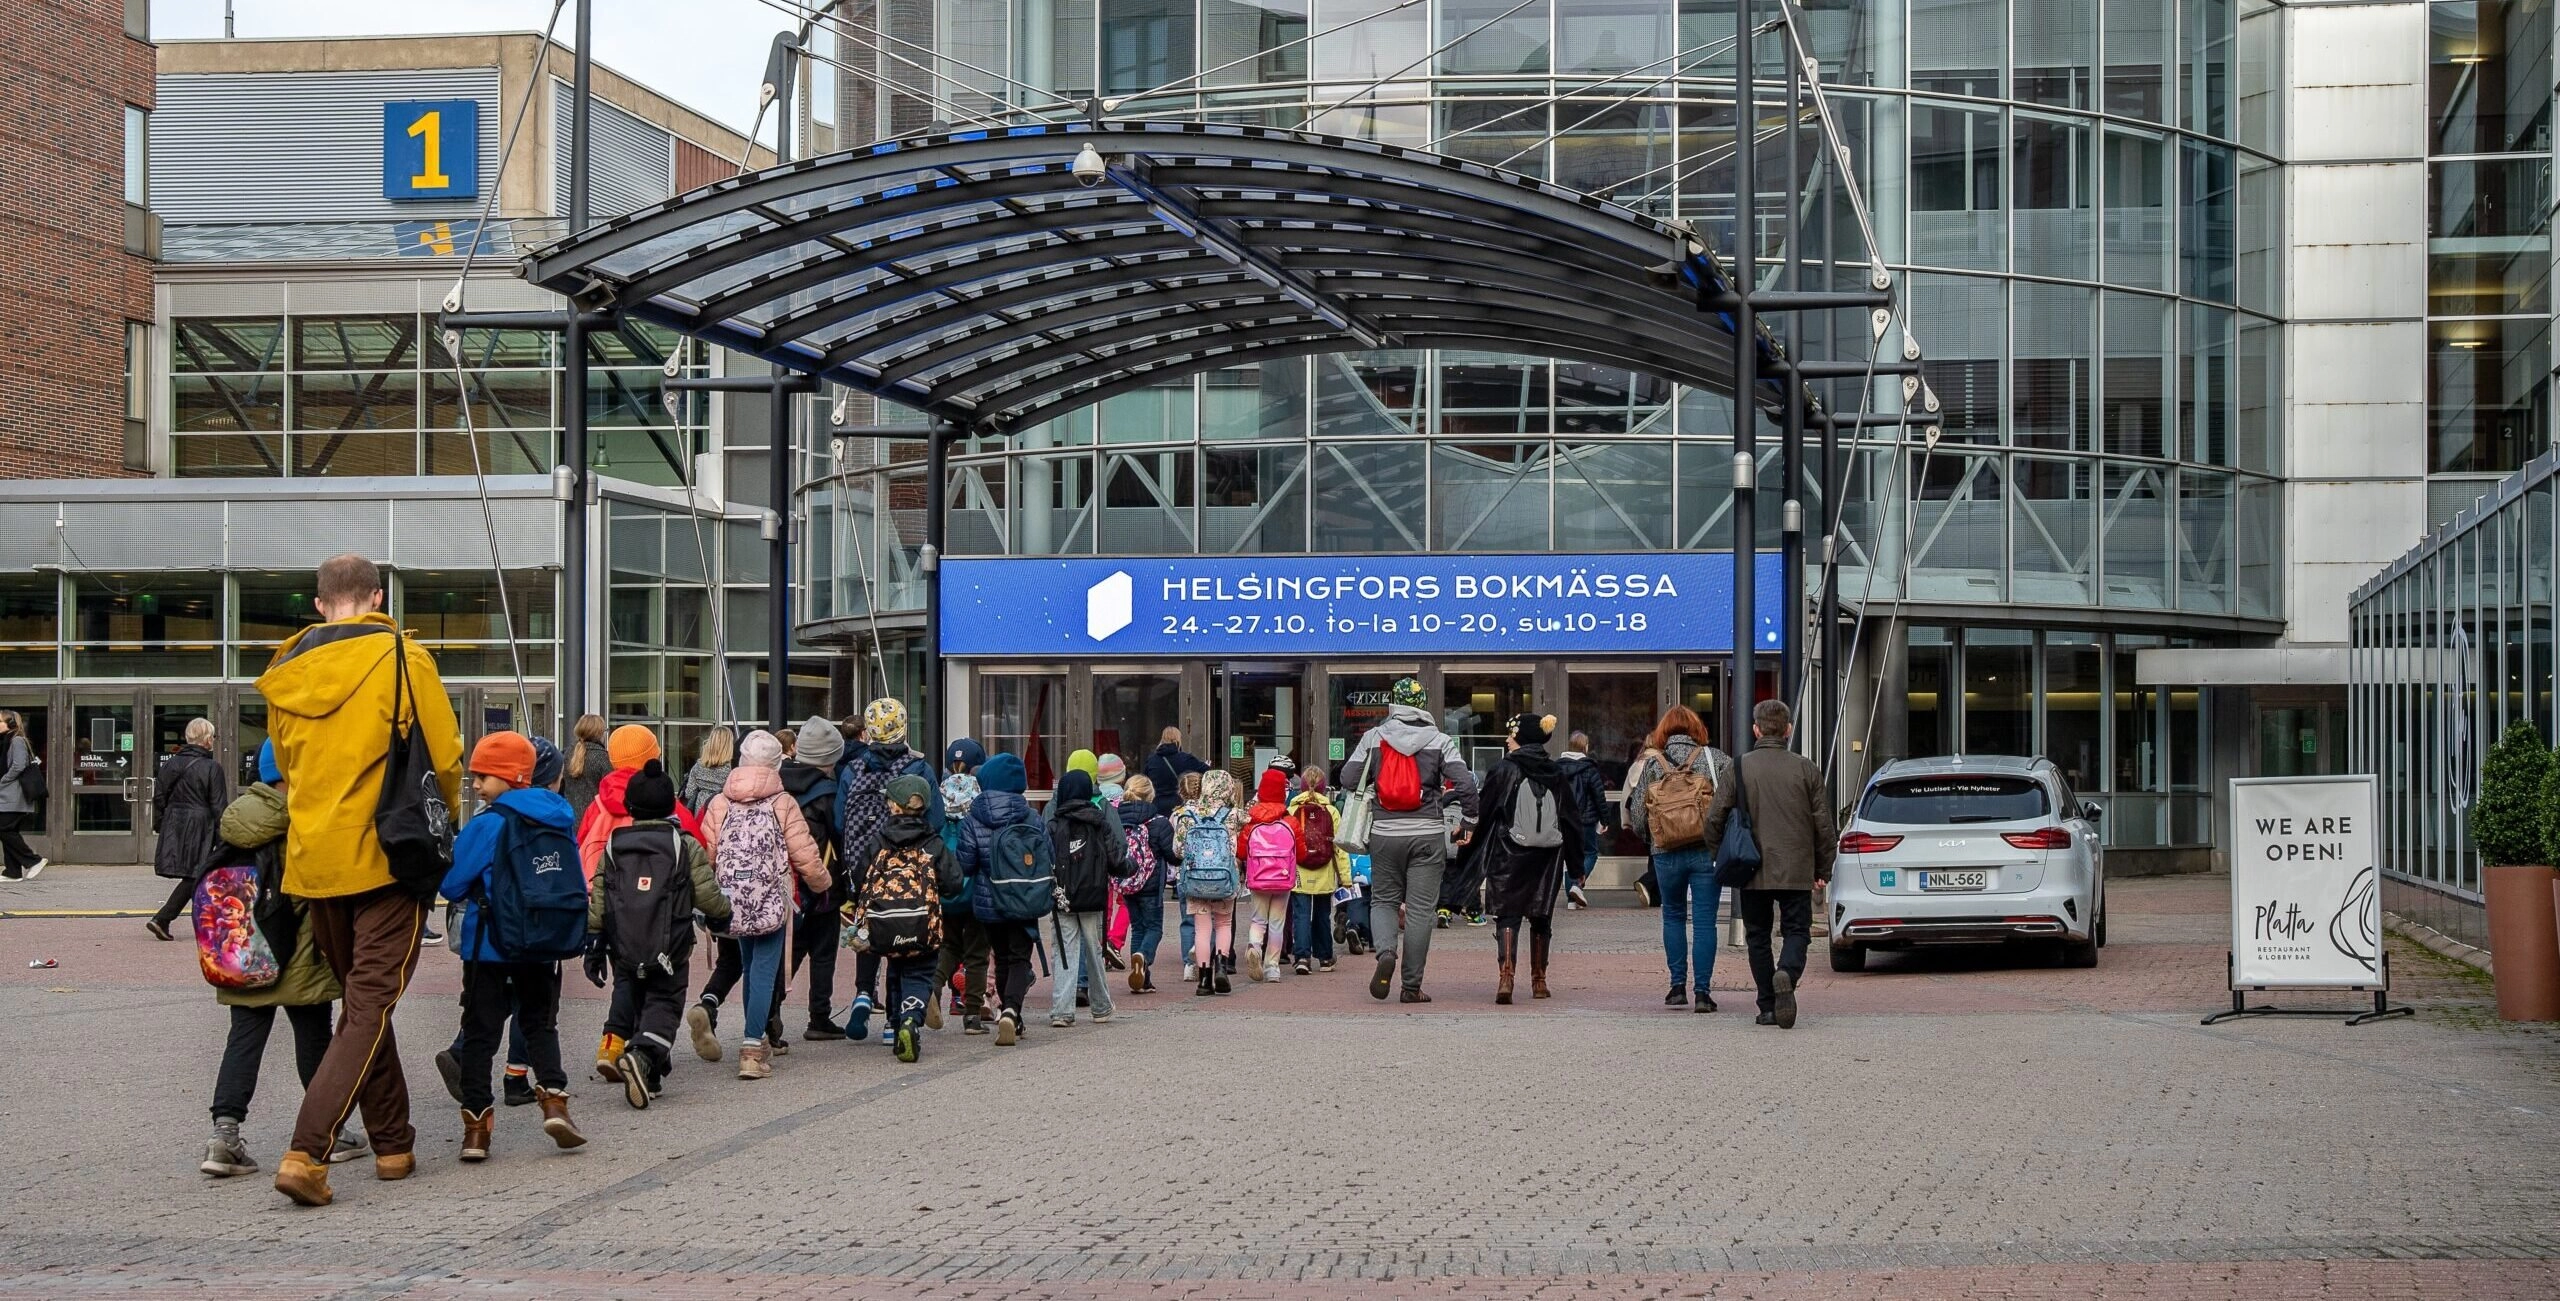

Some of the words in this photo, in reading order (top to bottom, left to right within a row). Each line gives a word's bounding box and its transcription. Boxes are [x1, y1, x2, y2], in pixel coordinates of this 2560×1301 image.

[2506, 133, 2514, 144] 3
[407, 112, 449, 189] 1
[2504, 427, 2513, 438] 2
[1163, 576, 1440, 601] HELSINGFORS
[1455, 568, 1678, 599] BOKMÄSSA
[1326, 612, 1397, 633] to-la
[1408, 613, 1507, 636] 10-20,
[1518, 617, 1552, 632] su
[1564, 613, 1648, 632] 10-18
[2256, 818, 2292, 836] WE
[2304, 817, 2352, 835] ARE
[2266, 843, 2343, 861] OPEN!
[1881, 874, 1894, 883] yle
[2255, 900, 2315, 941] Platta
